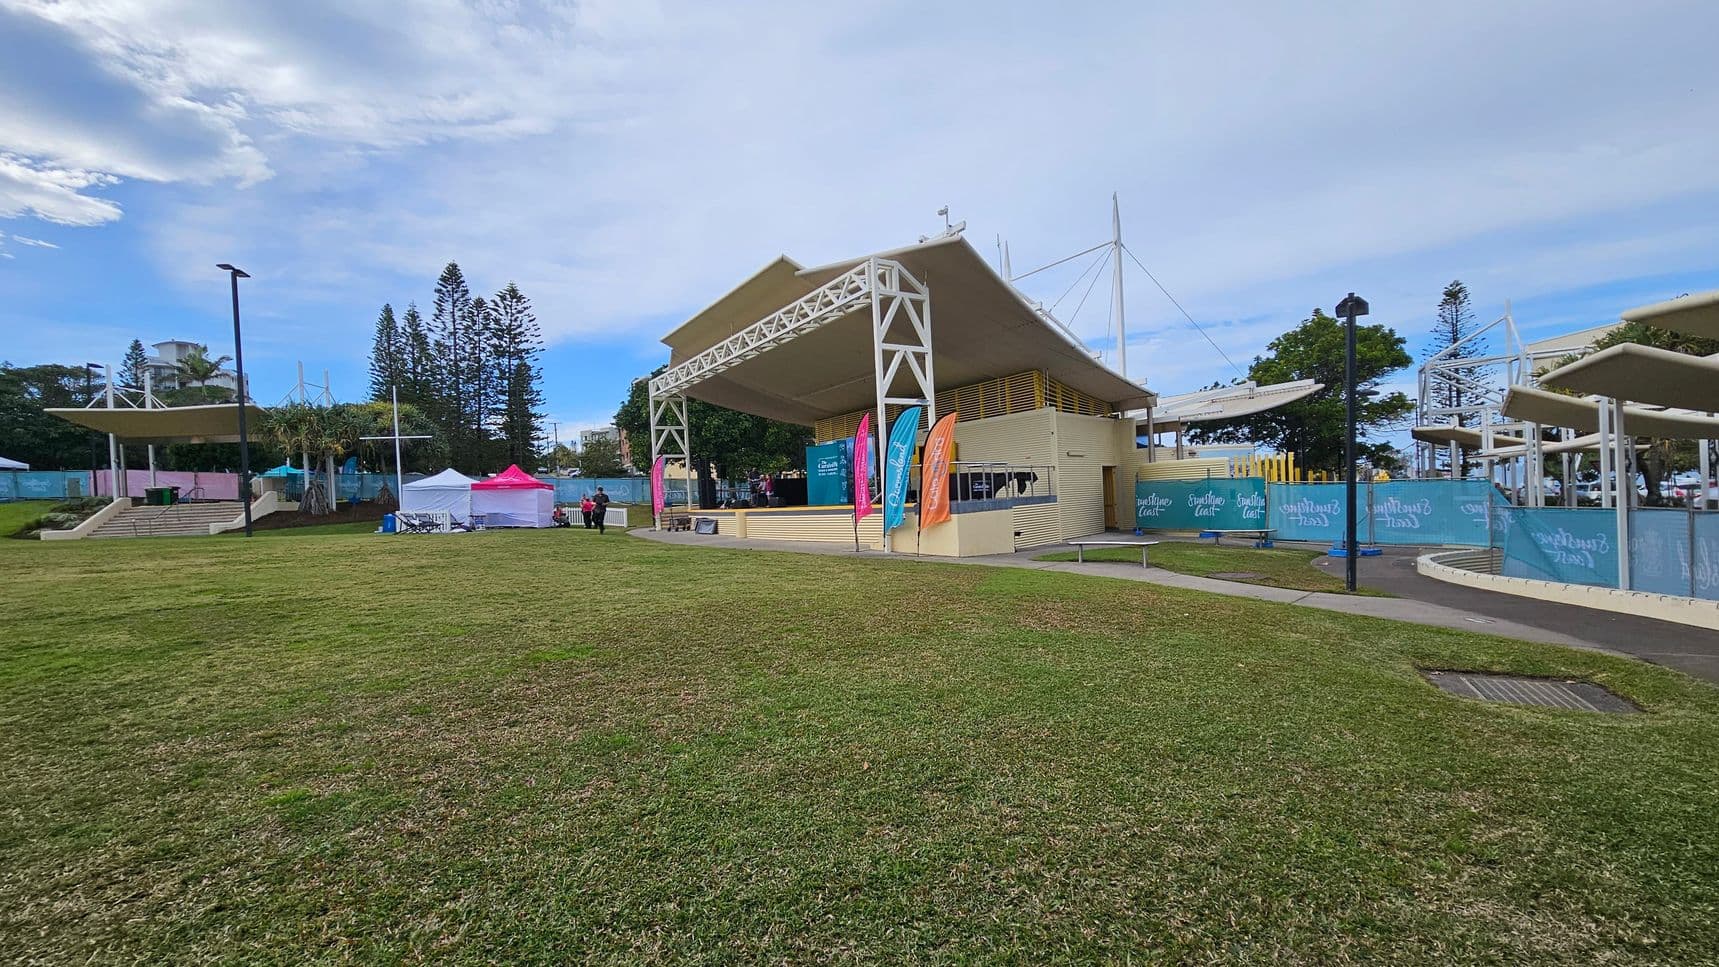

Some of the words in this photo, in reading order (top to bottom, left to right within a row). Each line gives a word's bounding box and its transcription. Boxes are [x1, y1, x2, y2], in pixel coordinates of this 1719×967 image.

[888, 441, 908, 507] Queensland
[1136, 493, 1172, 506] unshine
[1188, 491, 1225, 507] Sunshine
[1138, 506, 1165, 517] Coast
[1194, 505, 1220, 517] Coast
[1243, 506, 1265, 519] Coast
